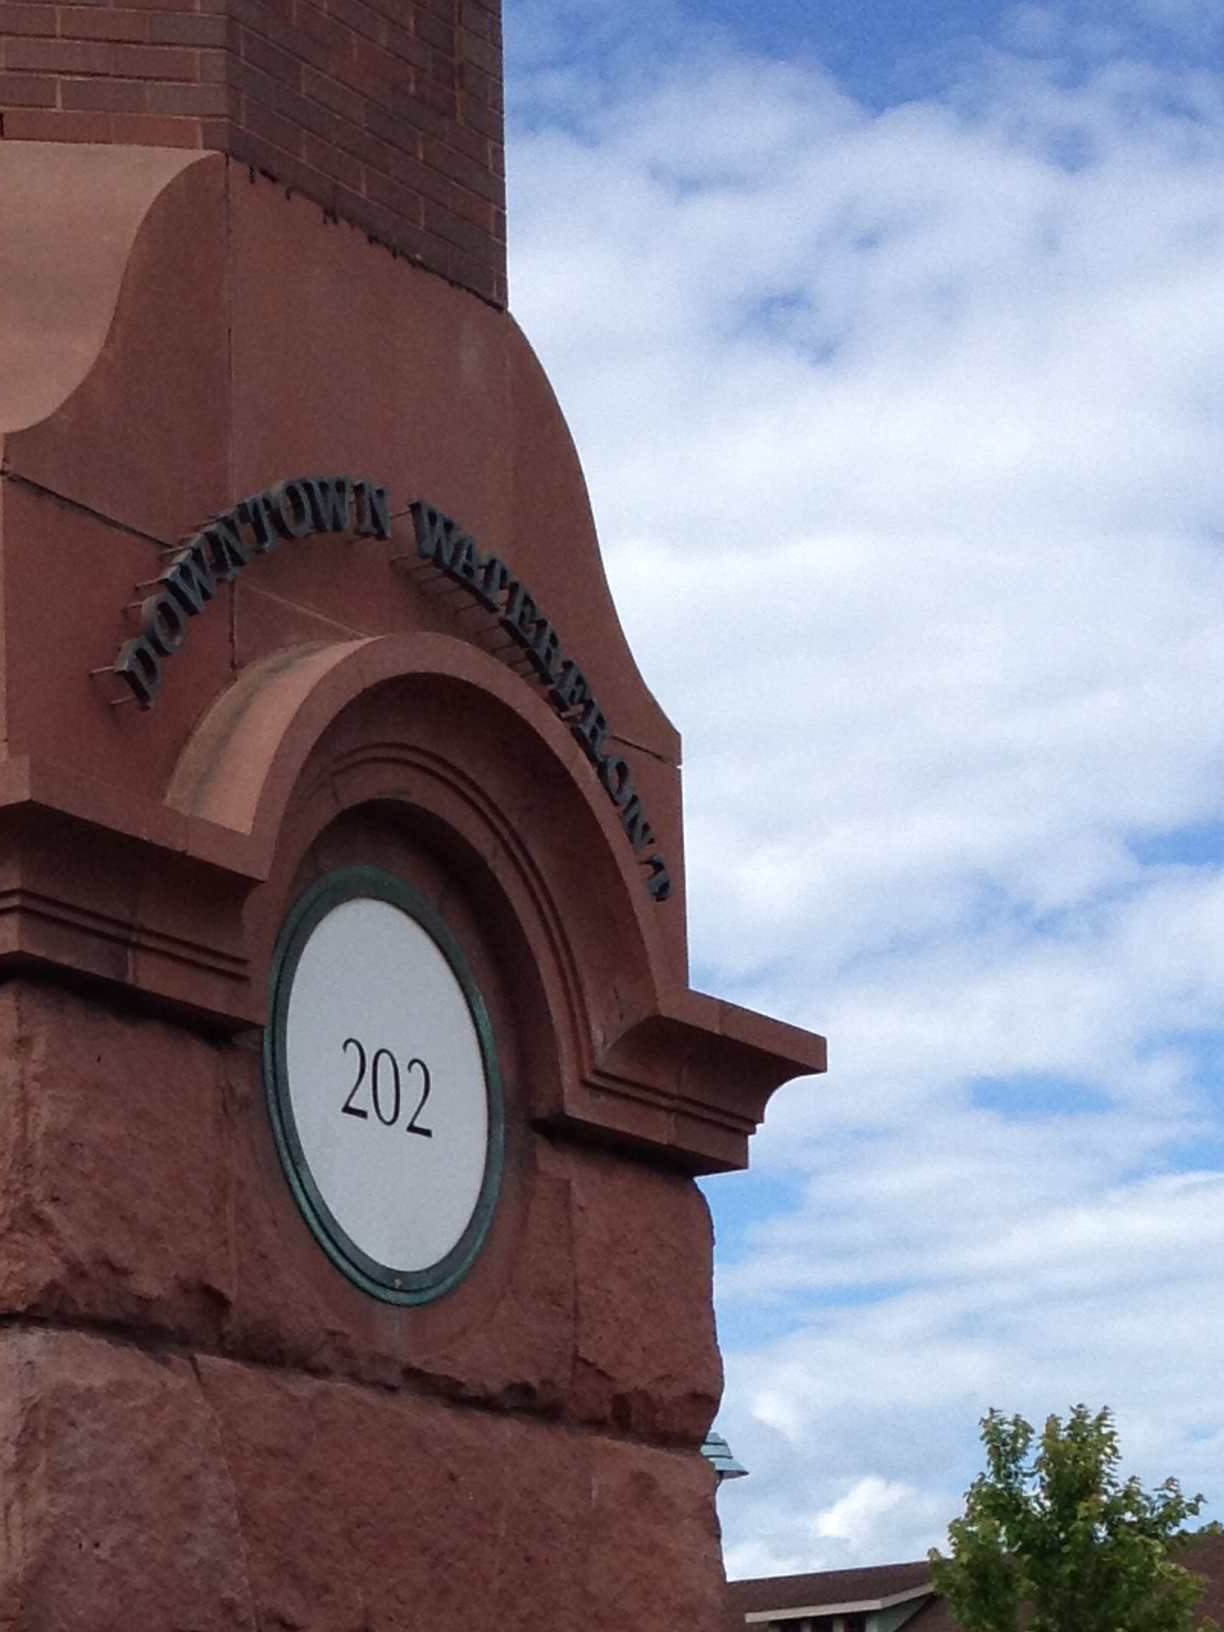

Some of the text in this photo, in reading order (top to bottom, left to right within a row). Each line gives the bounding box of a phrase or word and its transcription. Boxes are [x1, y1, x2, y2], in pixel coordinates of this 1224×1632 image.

[113, 475, 673, 901] DOWNTOWN WATERFRONT
[341, 1037, 433, 1138] 202
